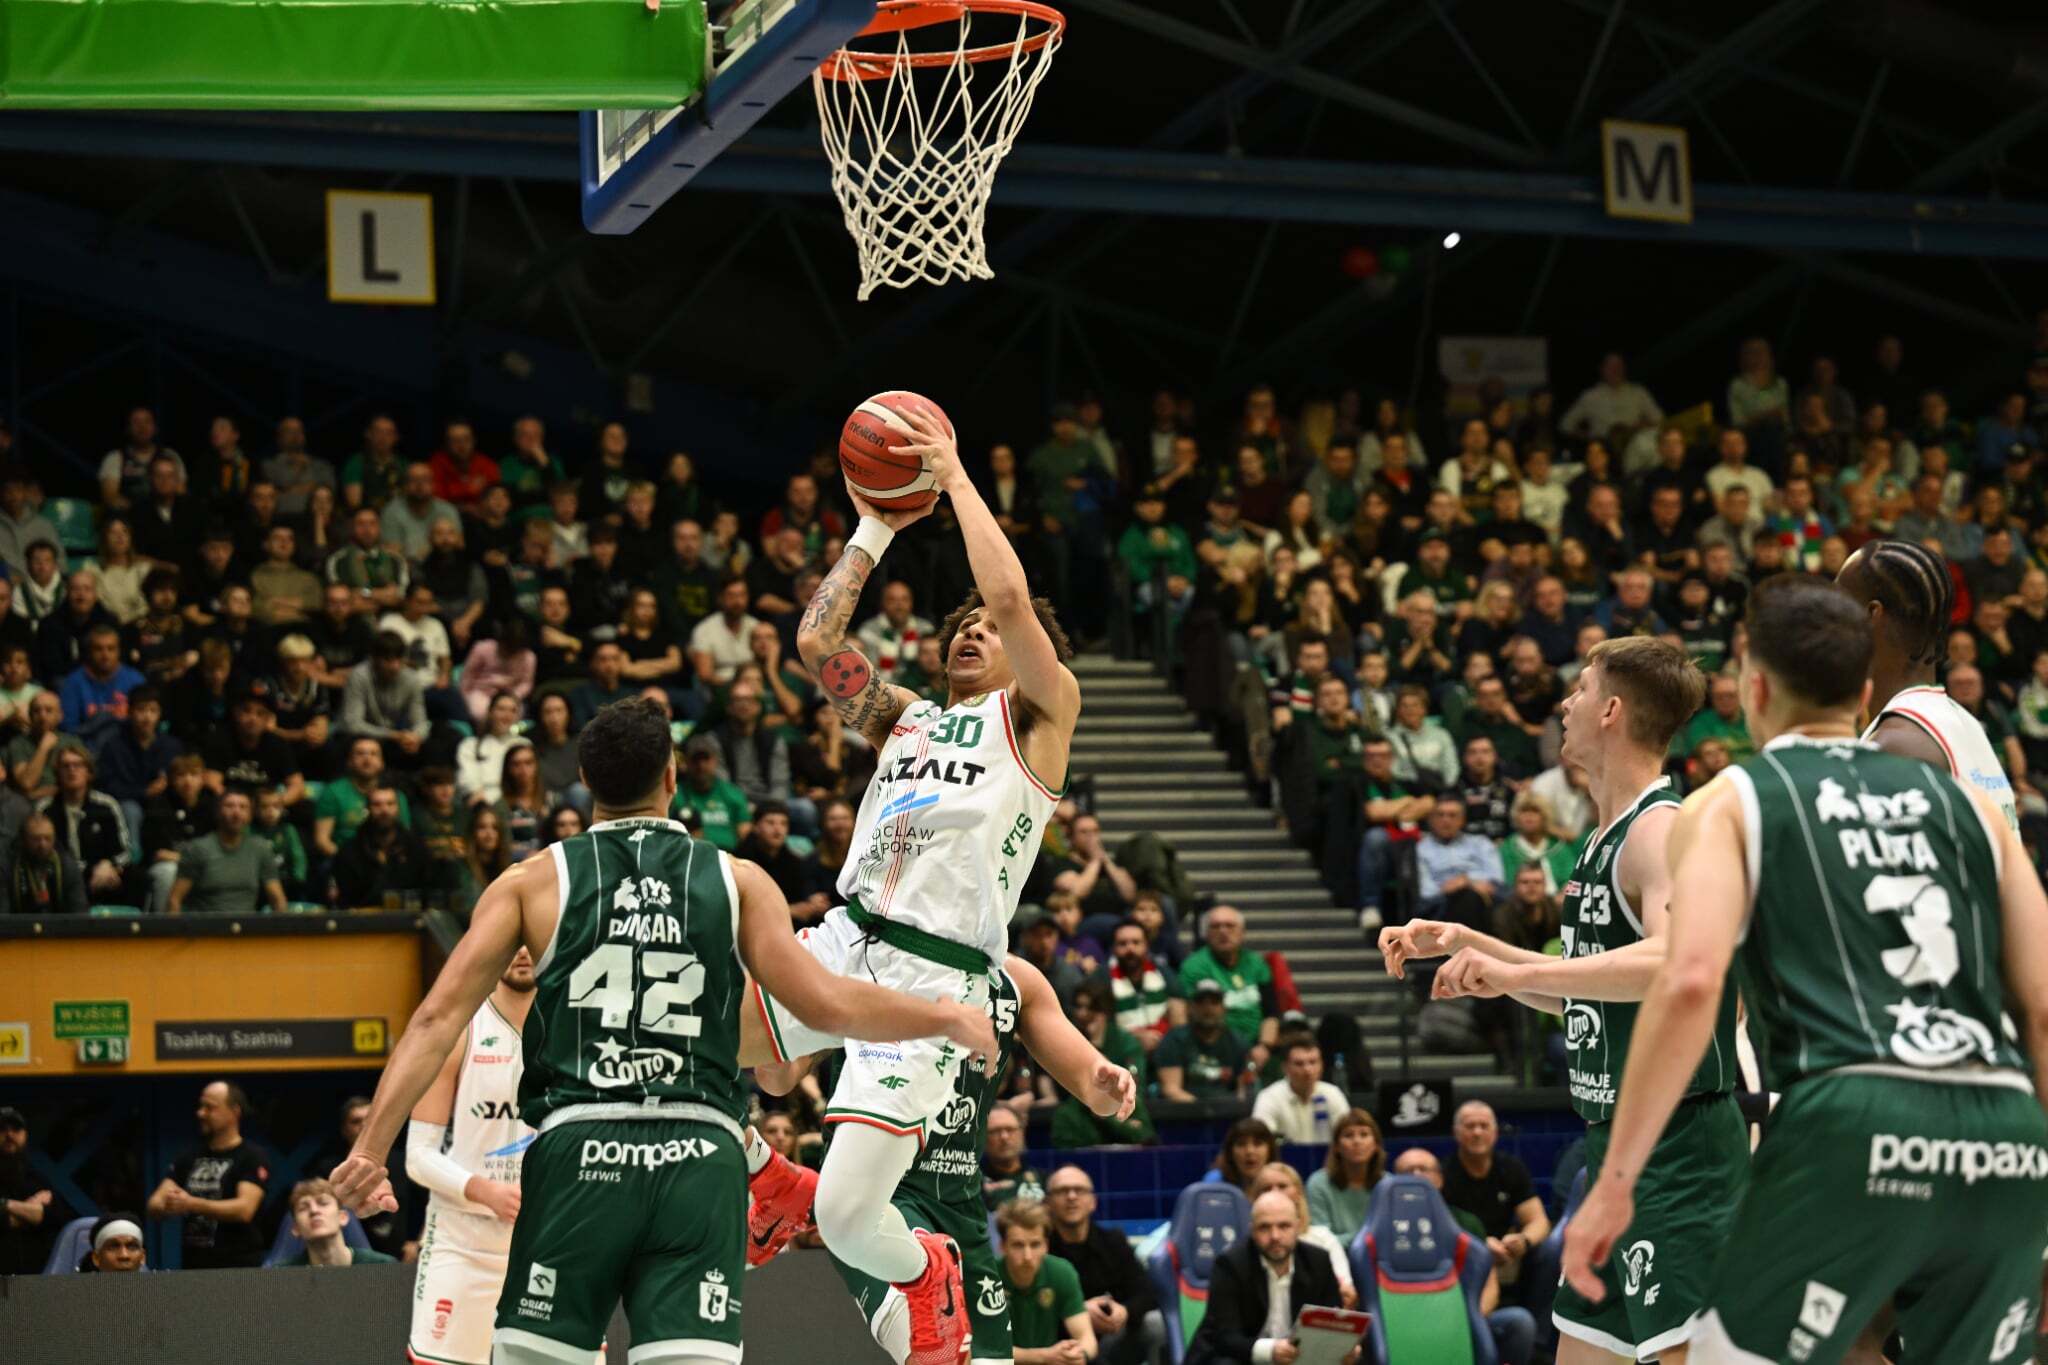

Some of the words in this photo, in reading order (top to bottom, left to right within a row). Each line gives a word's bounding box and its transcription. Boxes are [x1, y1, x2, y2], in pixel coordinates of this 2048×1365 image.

[1614, 139, 1682, 205] M
[361, 211, 400, 283] L
[848, 421, 885, 448] molten
[928, 714, 984, 748] 30
[871, 825, 936, 841] OCLAW
[1579, 883, 1611, 925] 23
[1863, 875, 1960, 988] 3
[568, 943, 706, 1037] 42
[231, 1029, 293, 1049] Szatnia
[604, 1054, 665, 1085] LOTTO
[580, 1138, 701, 1171] pompax
[1869, 1134, 2037, 1185] pompax
[577, 1169, 621, 1182] SERWIS
